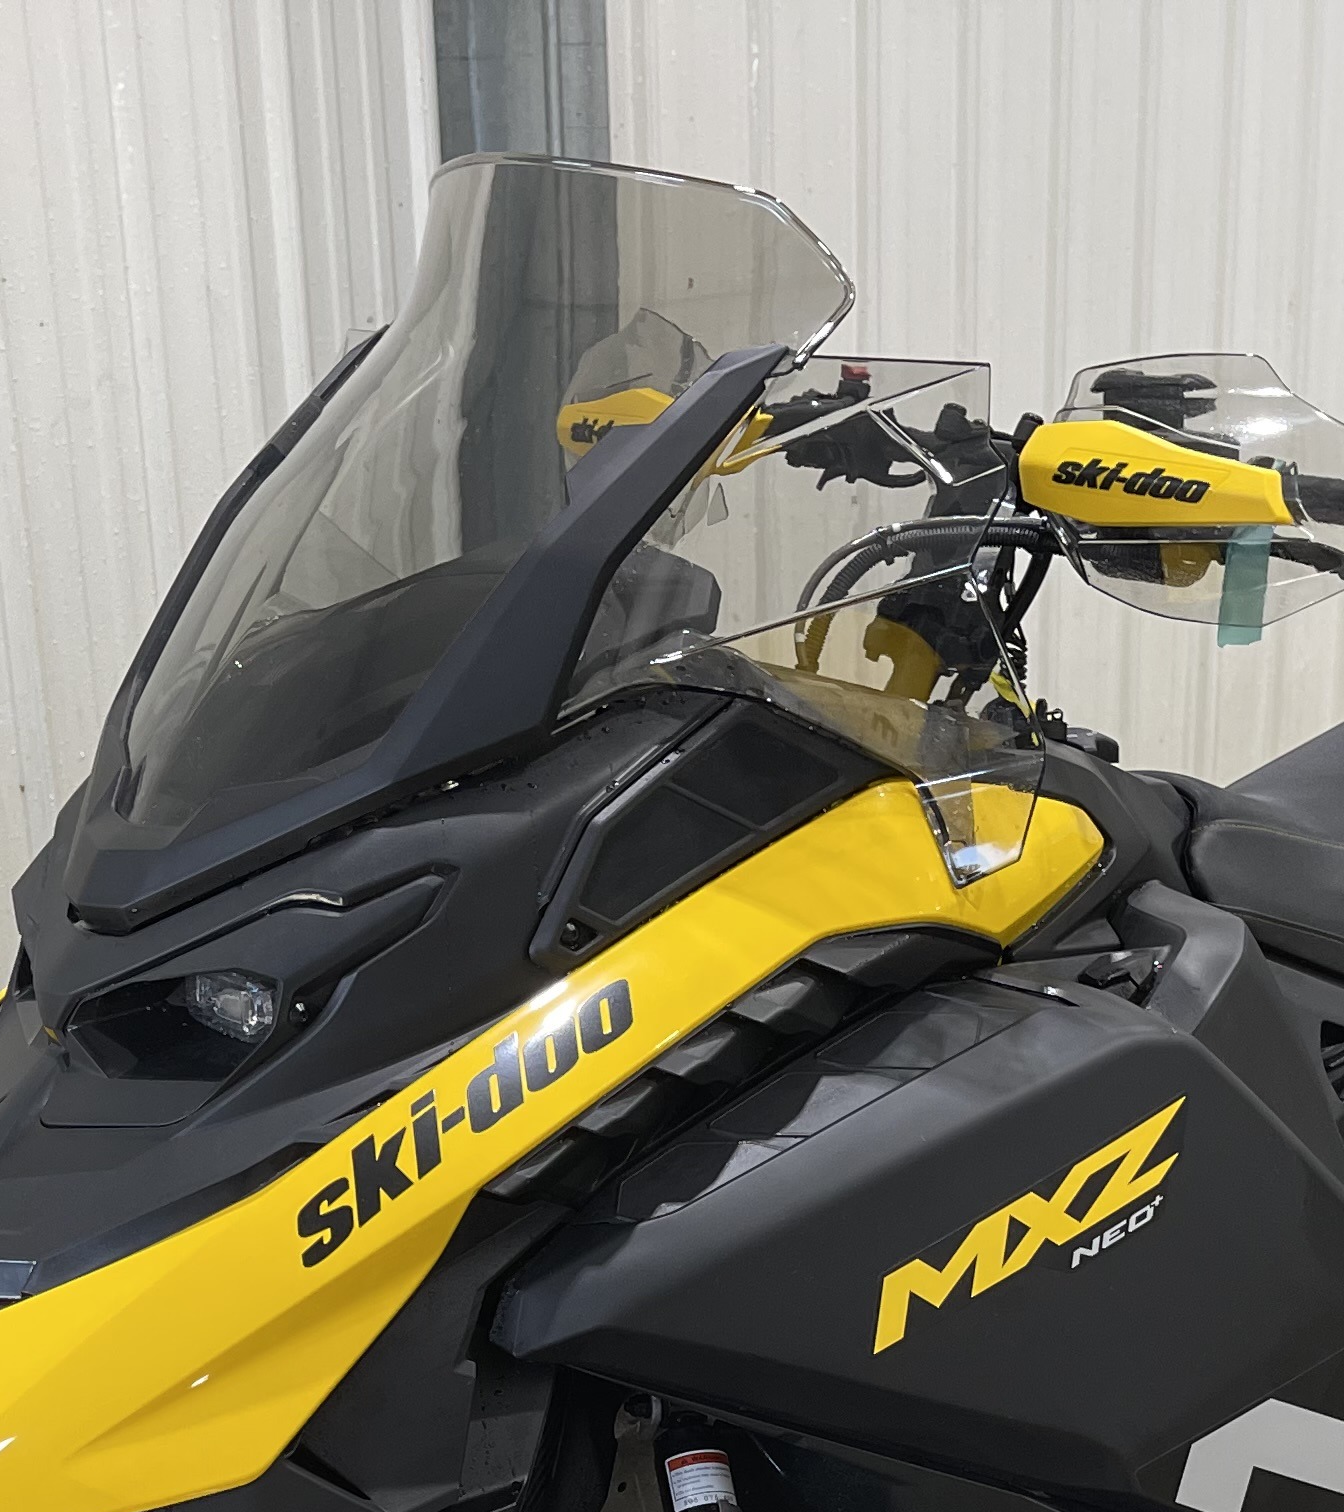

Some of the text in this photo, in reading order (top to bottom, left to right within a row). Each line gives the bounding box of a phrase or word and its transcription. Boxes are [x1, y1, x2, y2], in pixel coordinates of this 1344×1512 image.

[1052, 458, 1211, 504] ski-doo
[297, 979, 634, 1268] ski-doo
[873, 1096, 1186, 1354] MXZ
